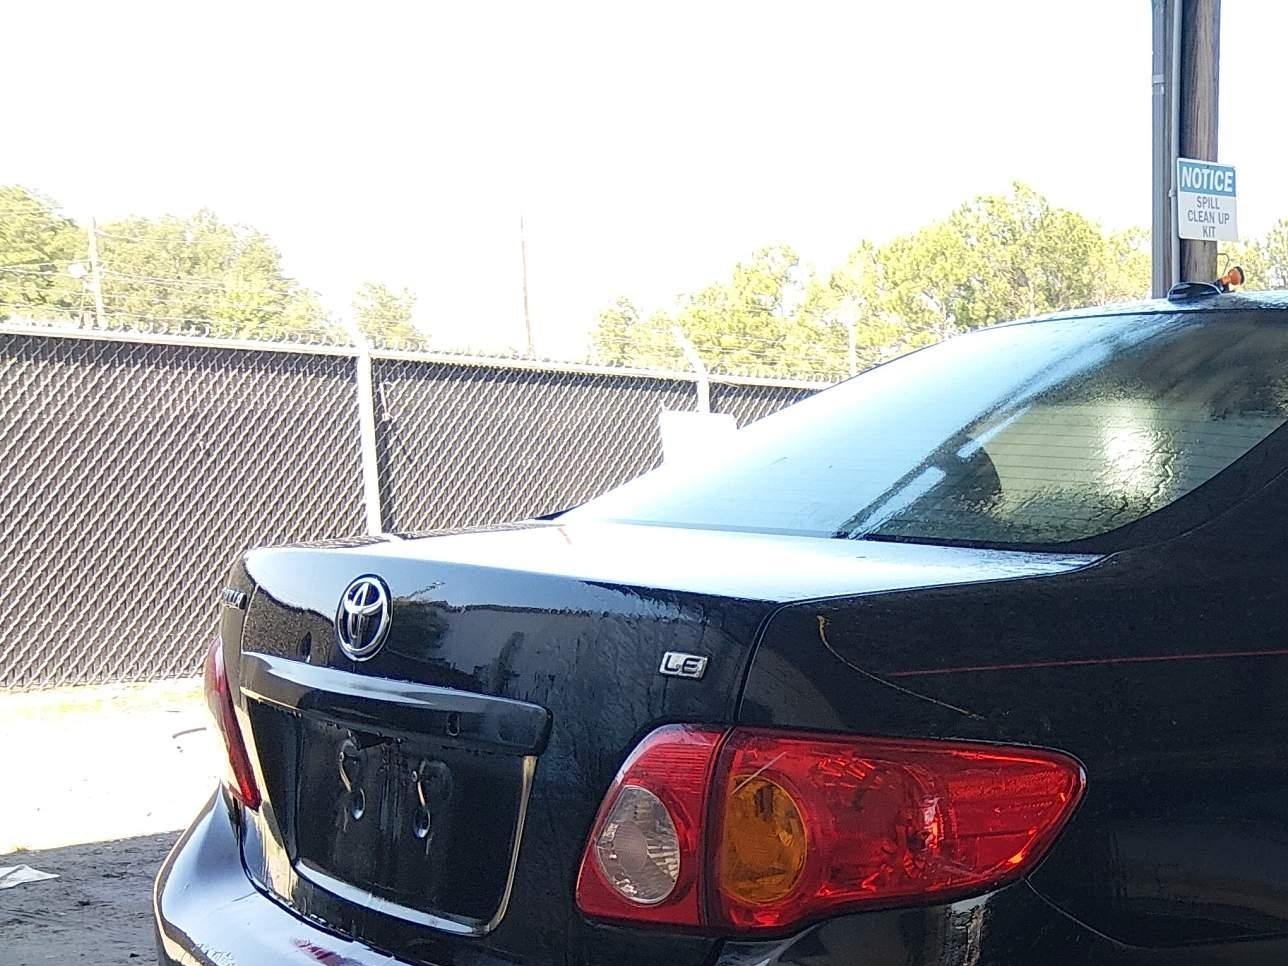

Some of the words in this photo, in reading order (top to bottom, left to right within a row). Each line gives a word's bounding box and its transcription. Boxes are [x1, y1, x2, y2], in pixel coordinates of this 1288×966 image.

[1181, 166, 1234, 192] NOTICE
[1196, 196, 1220, 210] SPILL
[1187, 210, 1215, 224] CLEAN
[1218, 213, 1230, 225] UP
[1202, 225, 1216, 238] KIT
[663, 653, 703, 675] LE
